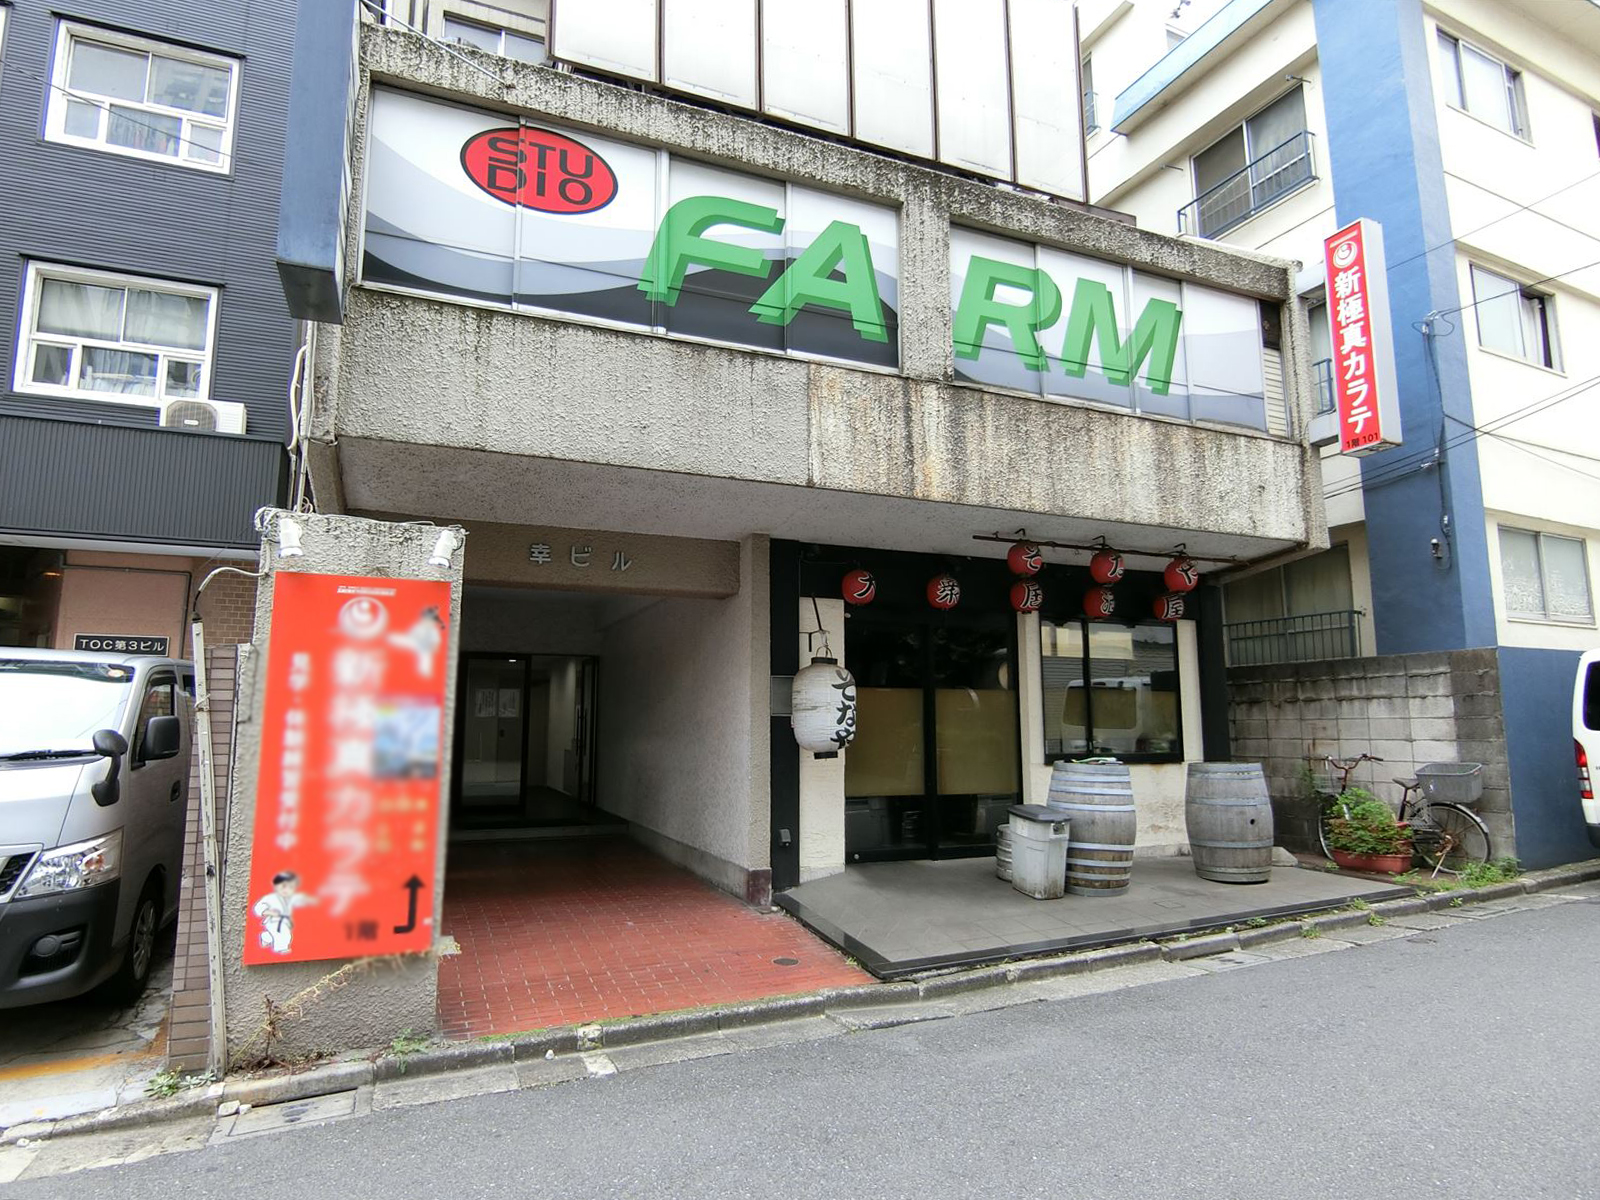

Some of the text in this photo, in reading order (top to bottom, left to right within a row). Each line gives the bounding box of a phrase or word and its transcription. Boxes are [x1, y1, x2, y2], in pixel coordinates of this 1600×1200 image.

[1334, 266, 1372, 434] 新極真カラテ
[1362, 432, 1379, 443] 101
[529, 543, 633, 572] 幸ビル
[80, 638, 165, 652] TOC第3ビル
